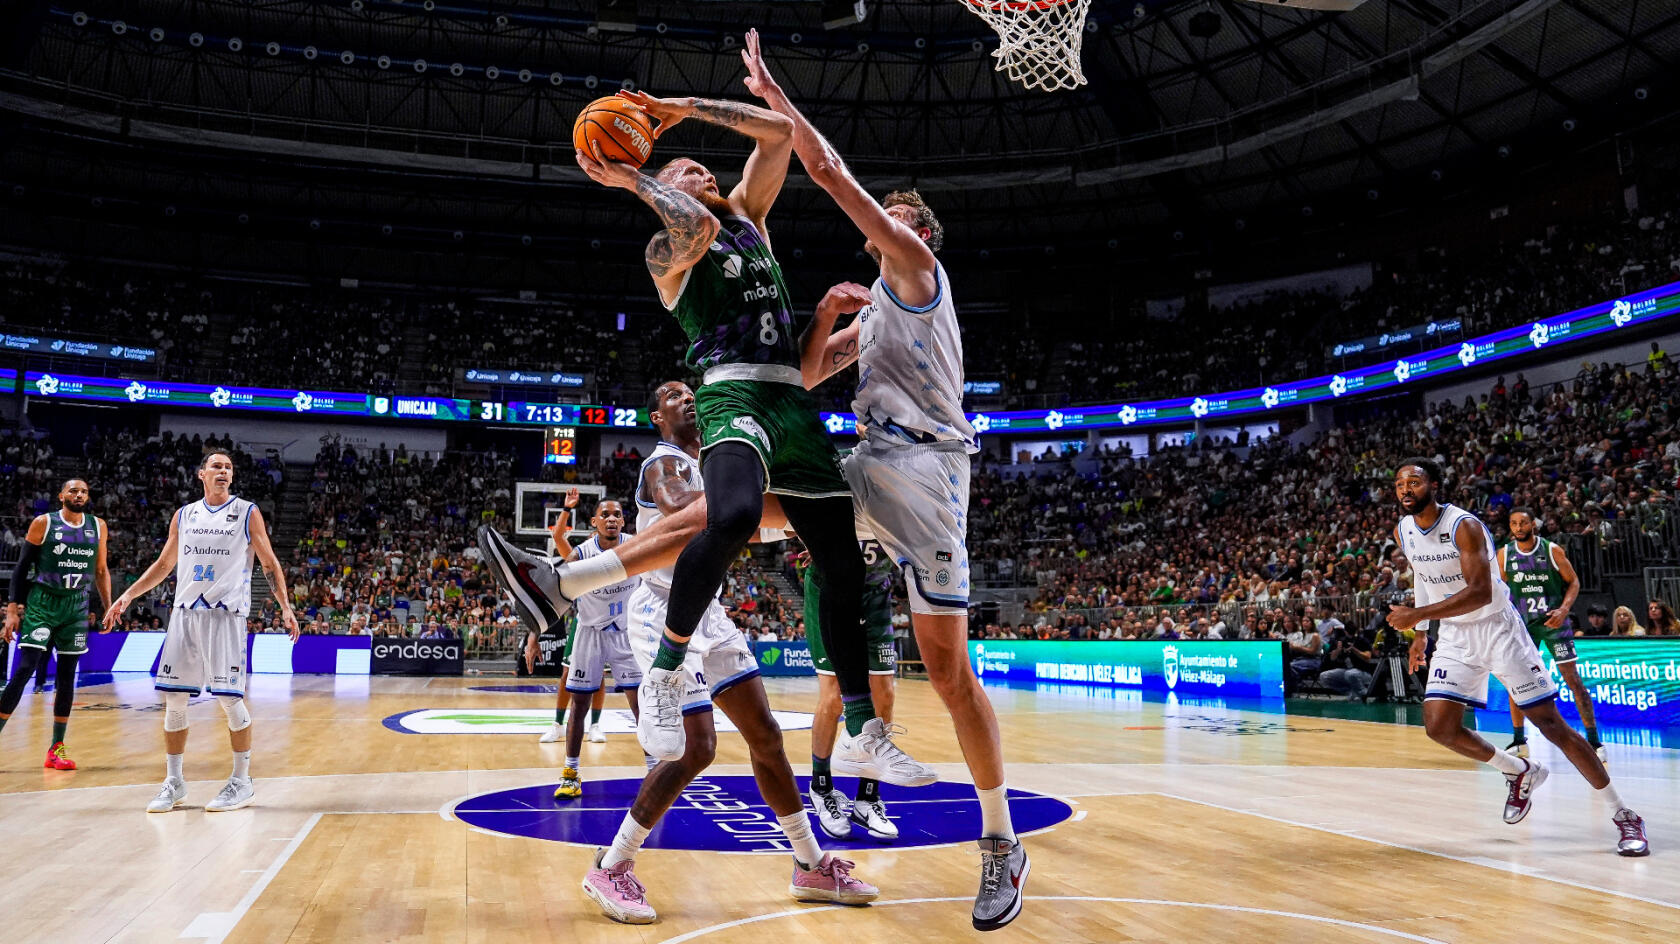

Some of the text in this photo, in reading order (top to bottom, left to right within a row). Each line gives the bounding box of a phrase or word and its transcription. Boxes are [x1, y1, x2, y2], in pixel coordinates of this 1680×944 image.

[760, 312, 779, 345] 8
[397, 400, 437, 416] UNICAJA
[481, 402, 502, 420] 31
[526, 405, 563, 422] 7:13
[585, 408, 605, 424] 12
[614, 409, 637, 426] 22
[553, 428, 575, 438] 7:12
[551, 439, 573, 455] 12
[192, 528, 235, 536] MORABANC
[68, 547, 94, 557] Unicaja
[192, 545, 230, 555] Andorra
[858, 541, 879, 565] 5
[62, 573, 83, 588] 17
[193, 564, 215, 582] 24
[608, 600, 623, 616] 11
[1527, 597, 1549, 613] 24
[374, 641, 459, 660] endesa
[1180, 654, 1238, 669] Ayuntamiento de
[1180, 669, 1226, 687] Vélez-Málaga
